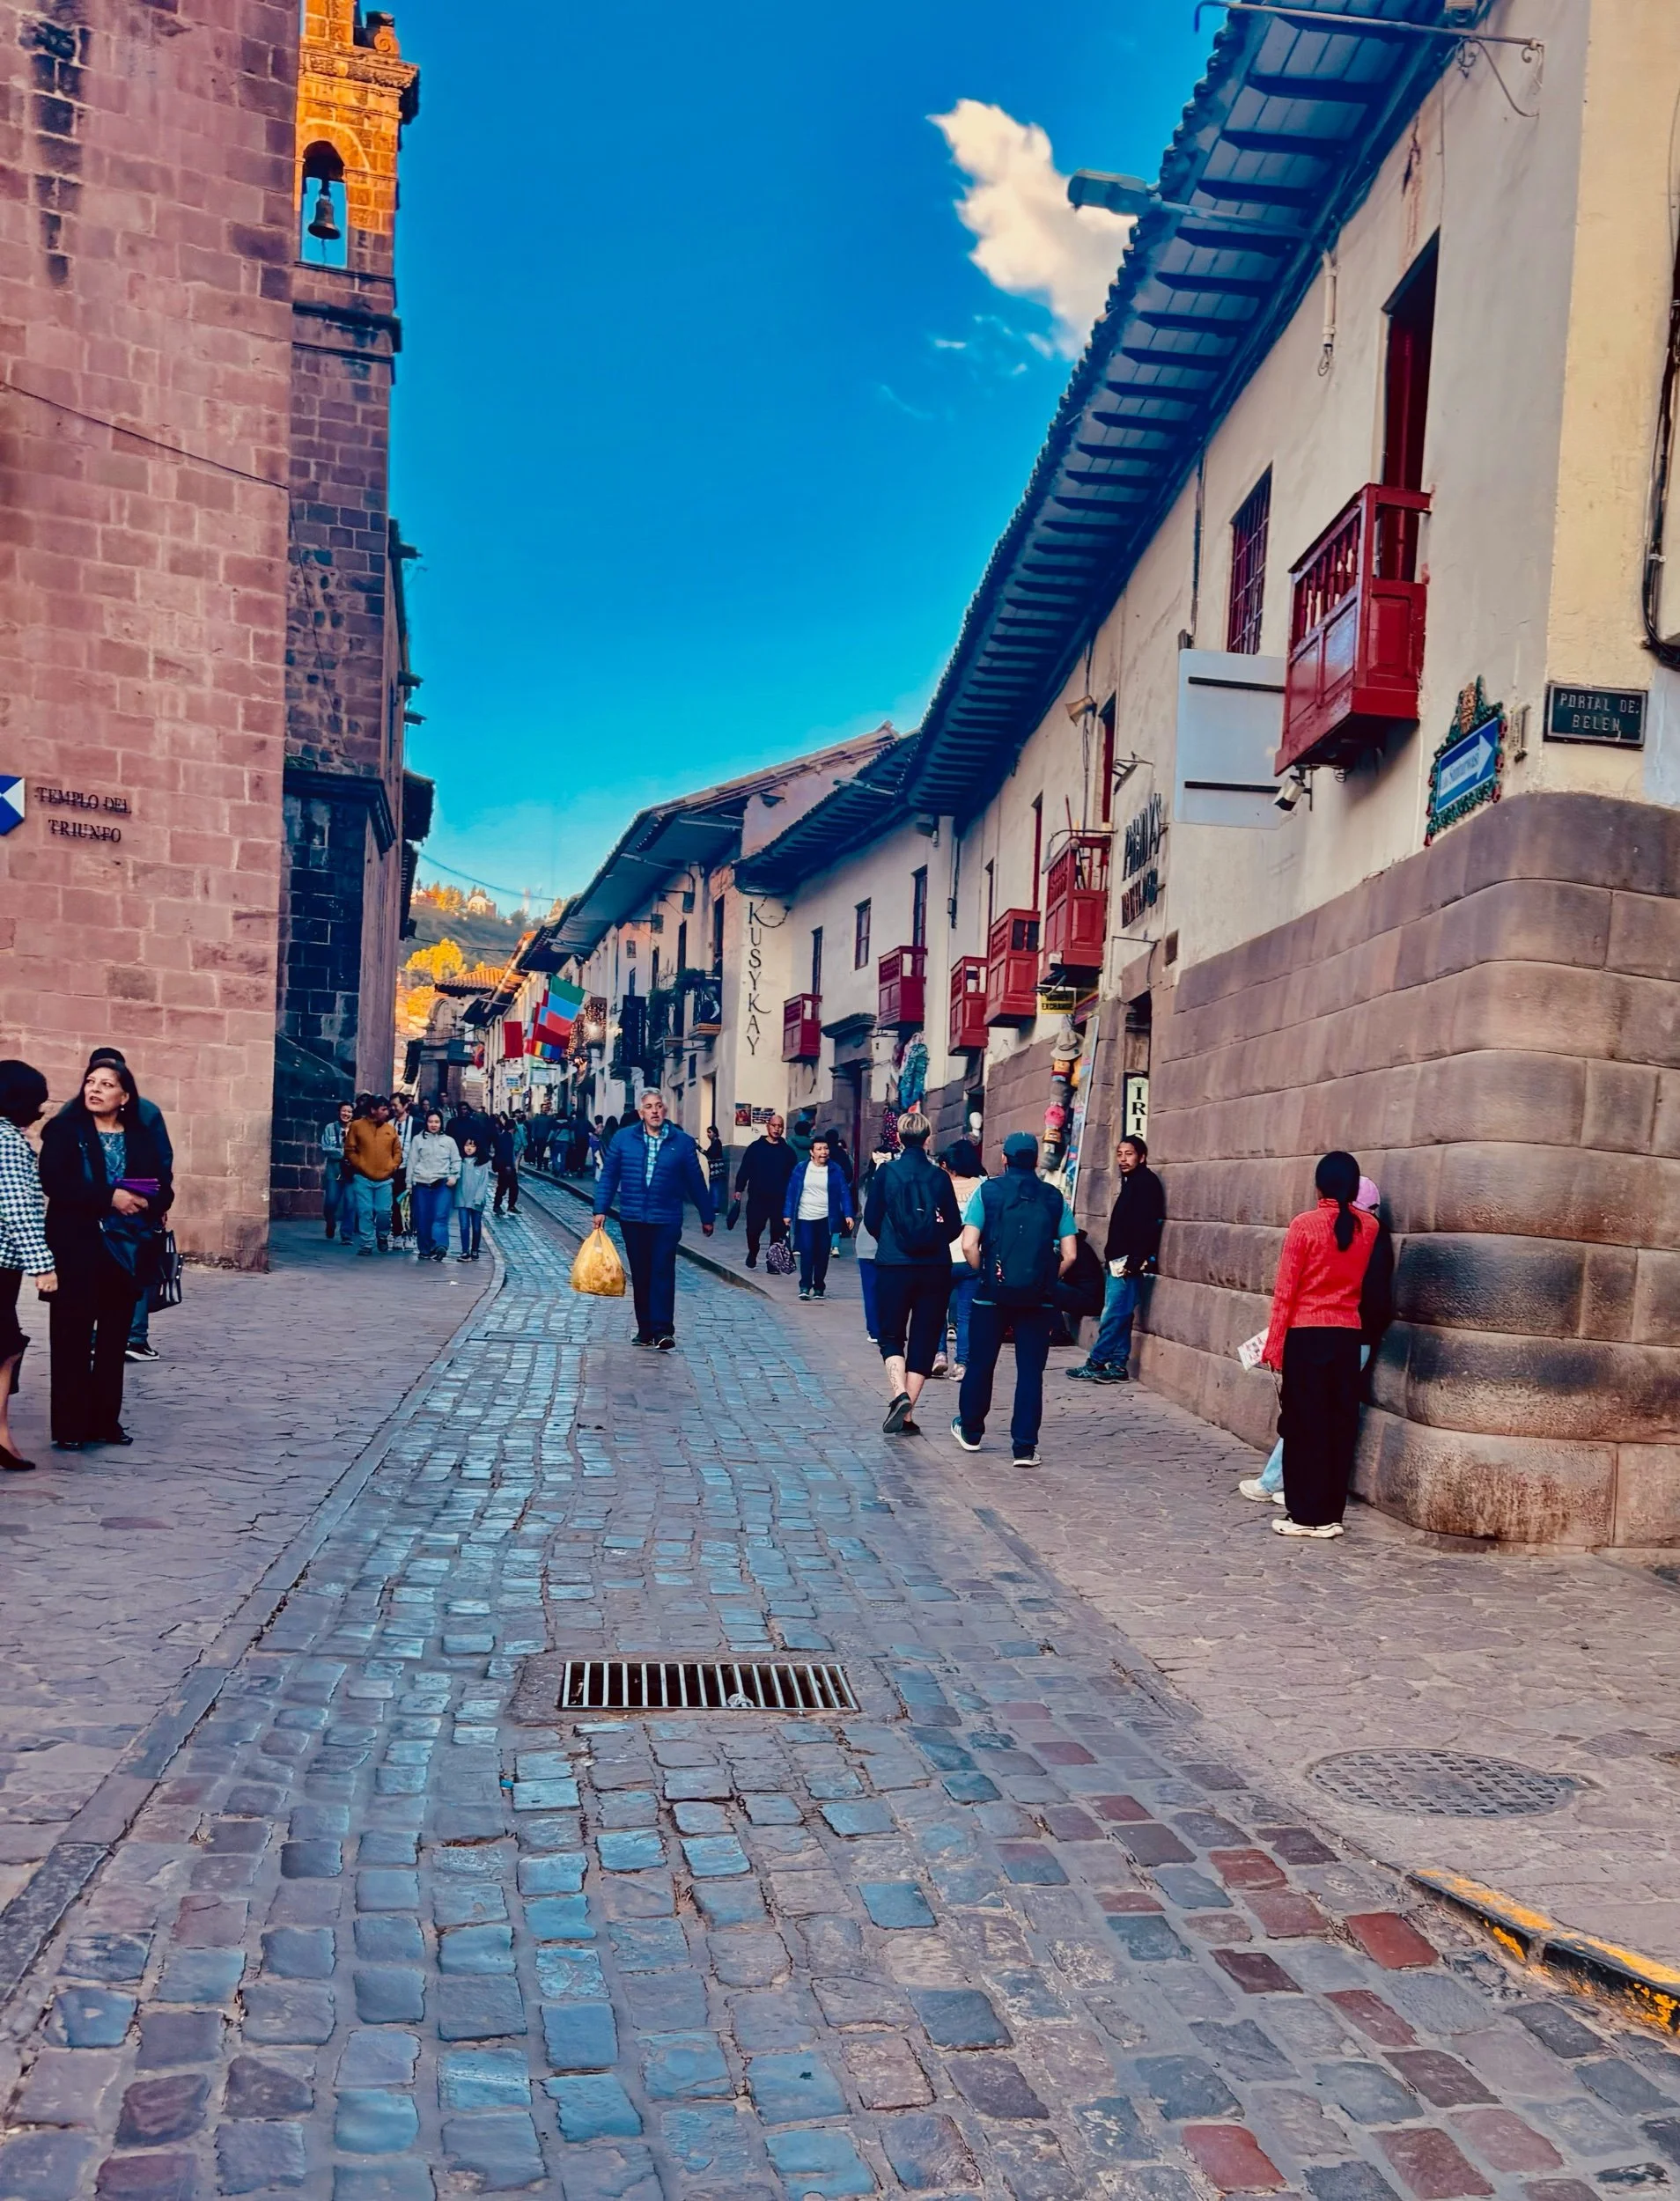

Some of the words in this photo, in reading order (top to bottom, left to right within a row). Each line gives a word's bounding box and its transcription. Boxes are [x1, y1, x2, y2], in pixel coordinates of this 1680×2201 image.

[1559, 692, 1610, 712] PORTAL
[1572, 714, 1621, 732] BELEN
[35, 786, 99, 809] TEMPLO
[103, 796, 131, 814] DEL
[48, 819, 122, 843] TRIUNFO
[747, 898, 785, 1056] KUSYKAY
[1131, 1086, 1146, 1137] IRI
